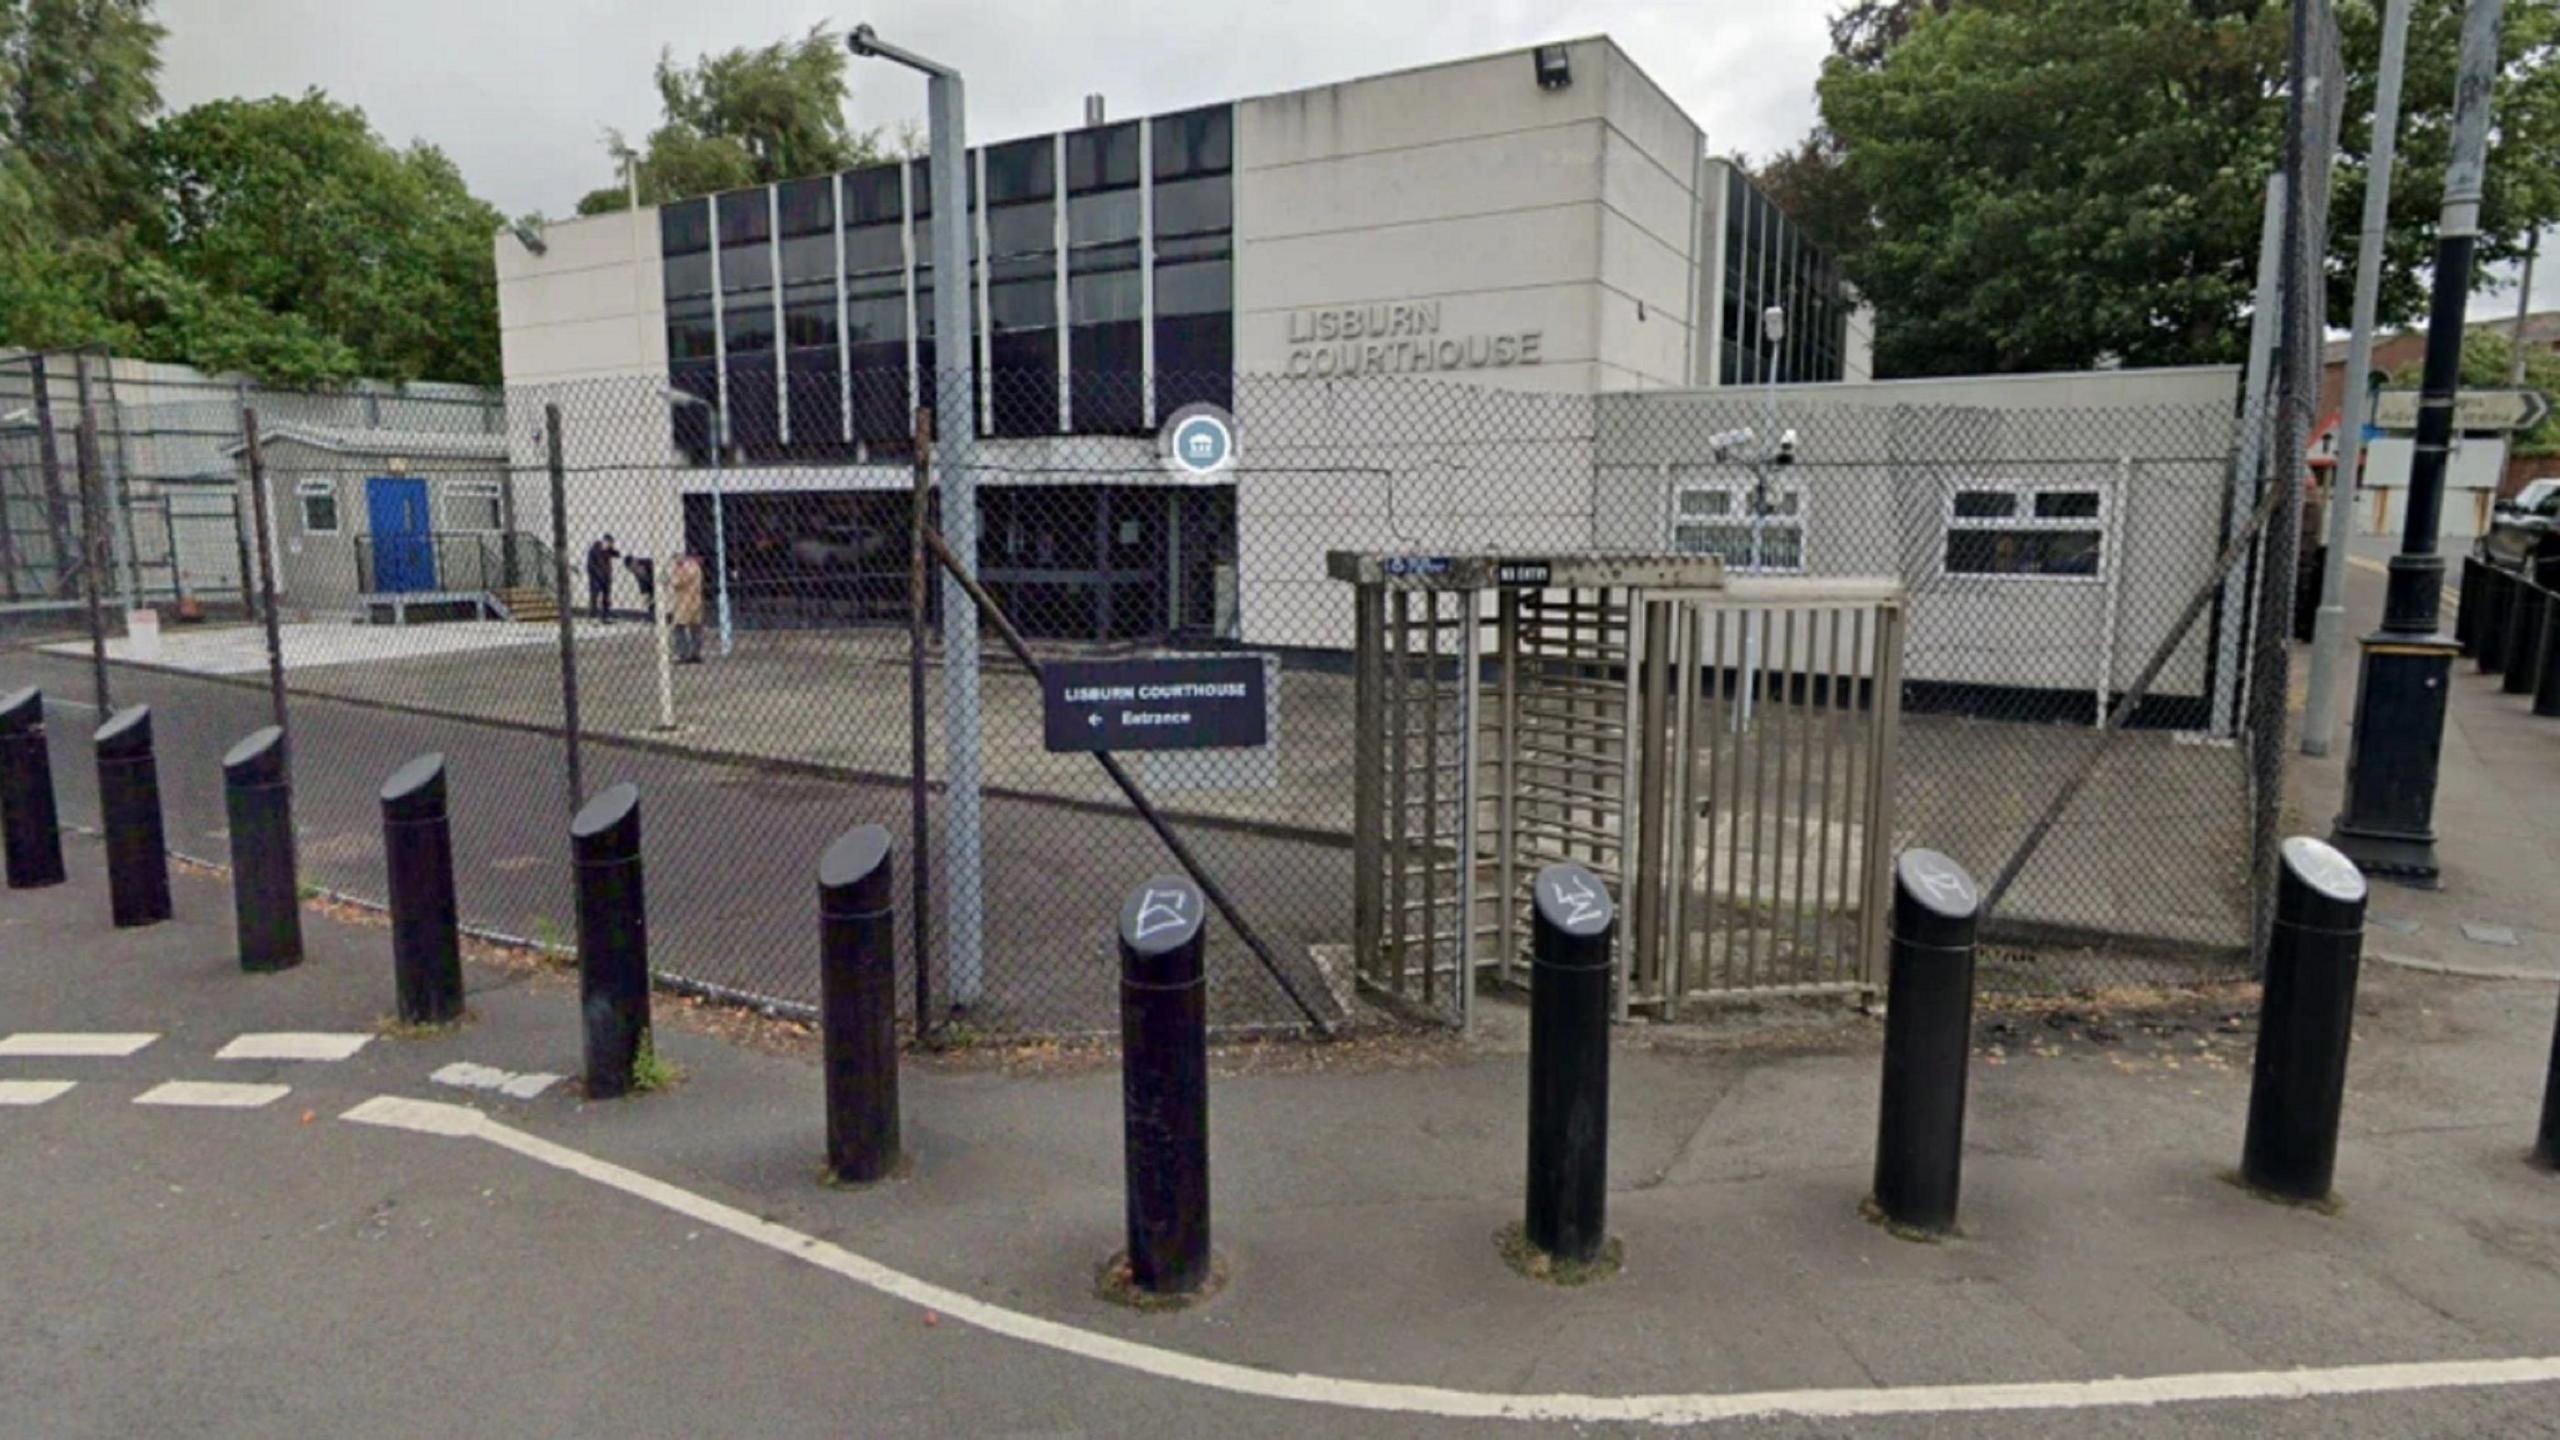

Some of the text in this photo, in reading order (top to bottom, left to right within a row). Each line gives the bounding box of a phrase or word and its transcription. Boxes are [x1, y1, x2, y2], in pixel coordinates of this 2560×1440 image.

[1288, 301, 1440, 343] LISBURN
[1289, 331, 1542, 378] COURTHOUSE
[1064, 682, 1247, 702] LISBURN COURTHOUSE
[1121, 710, 1192, 726] Entrance
